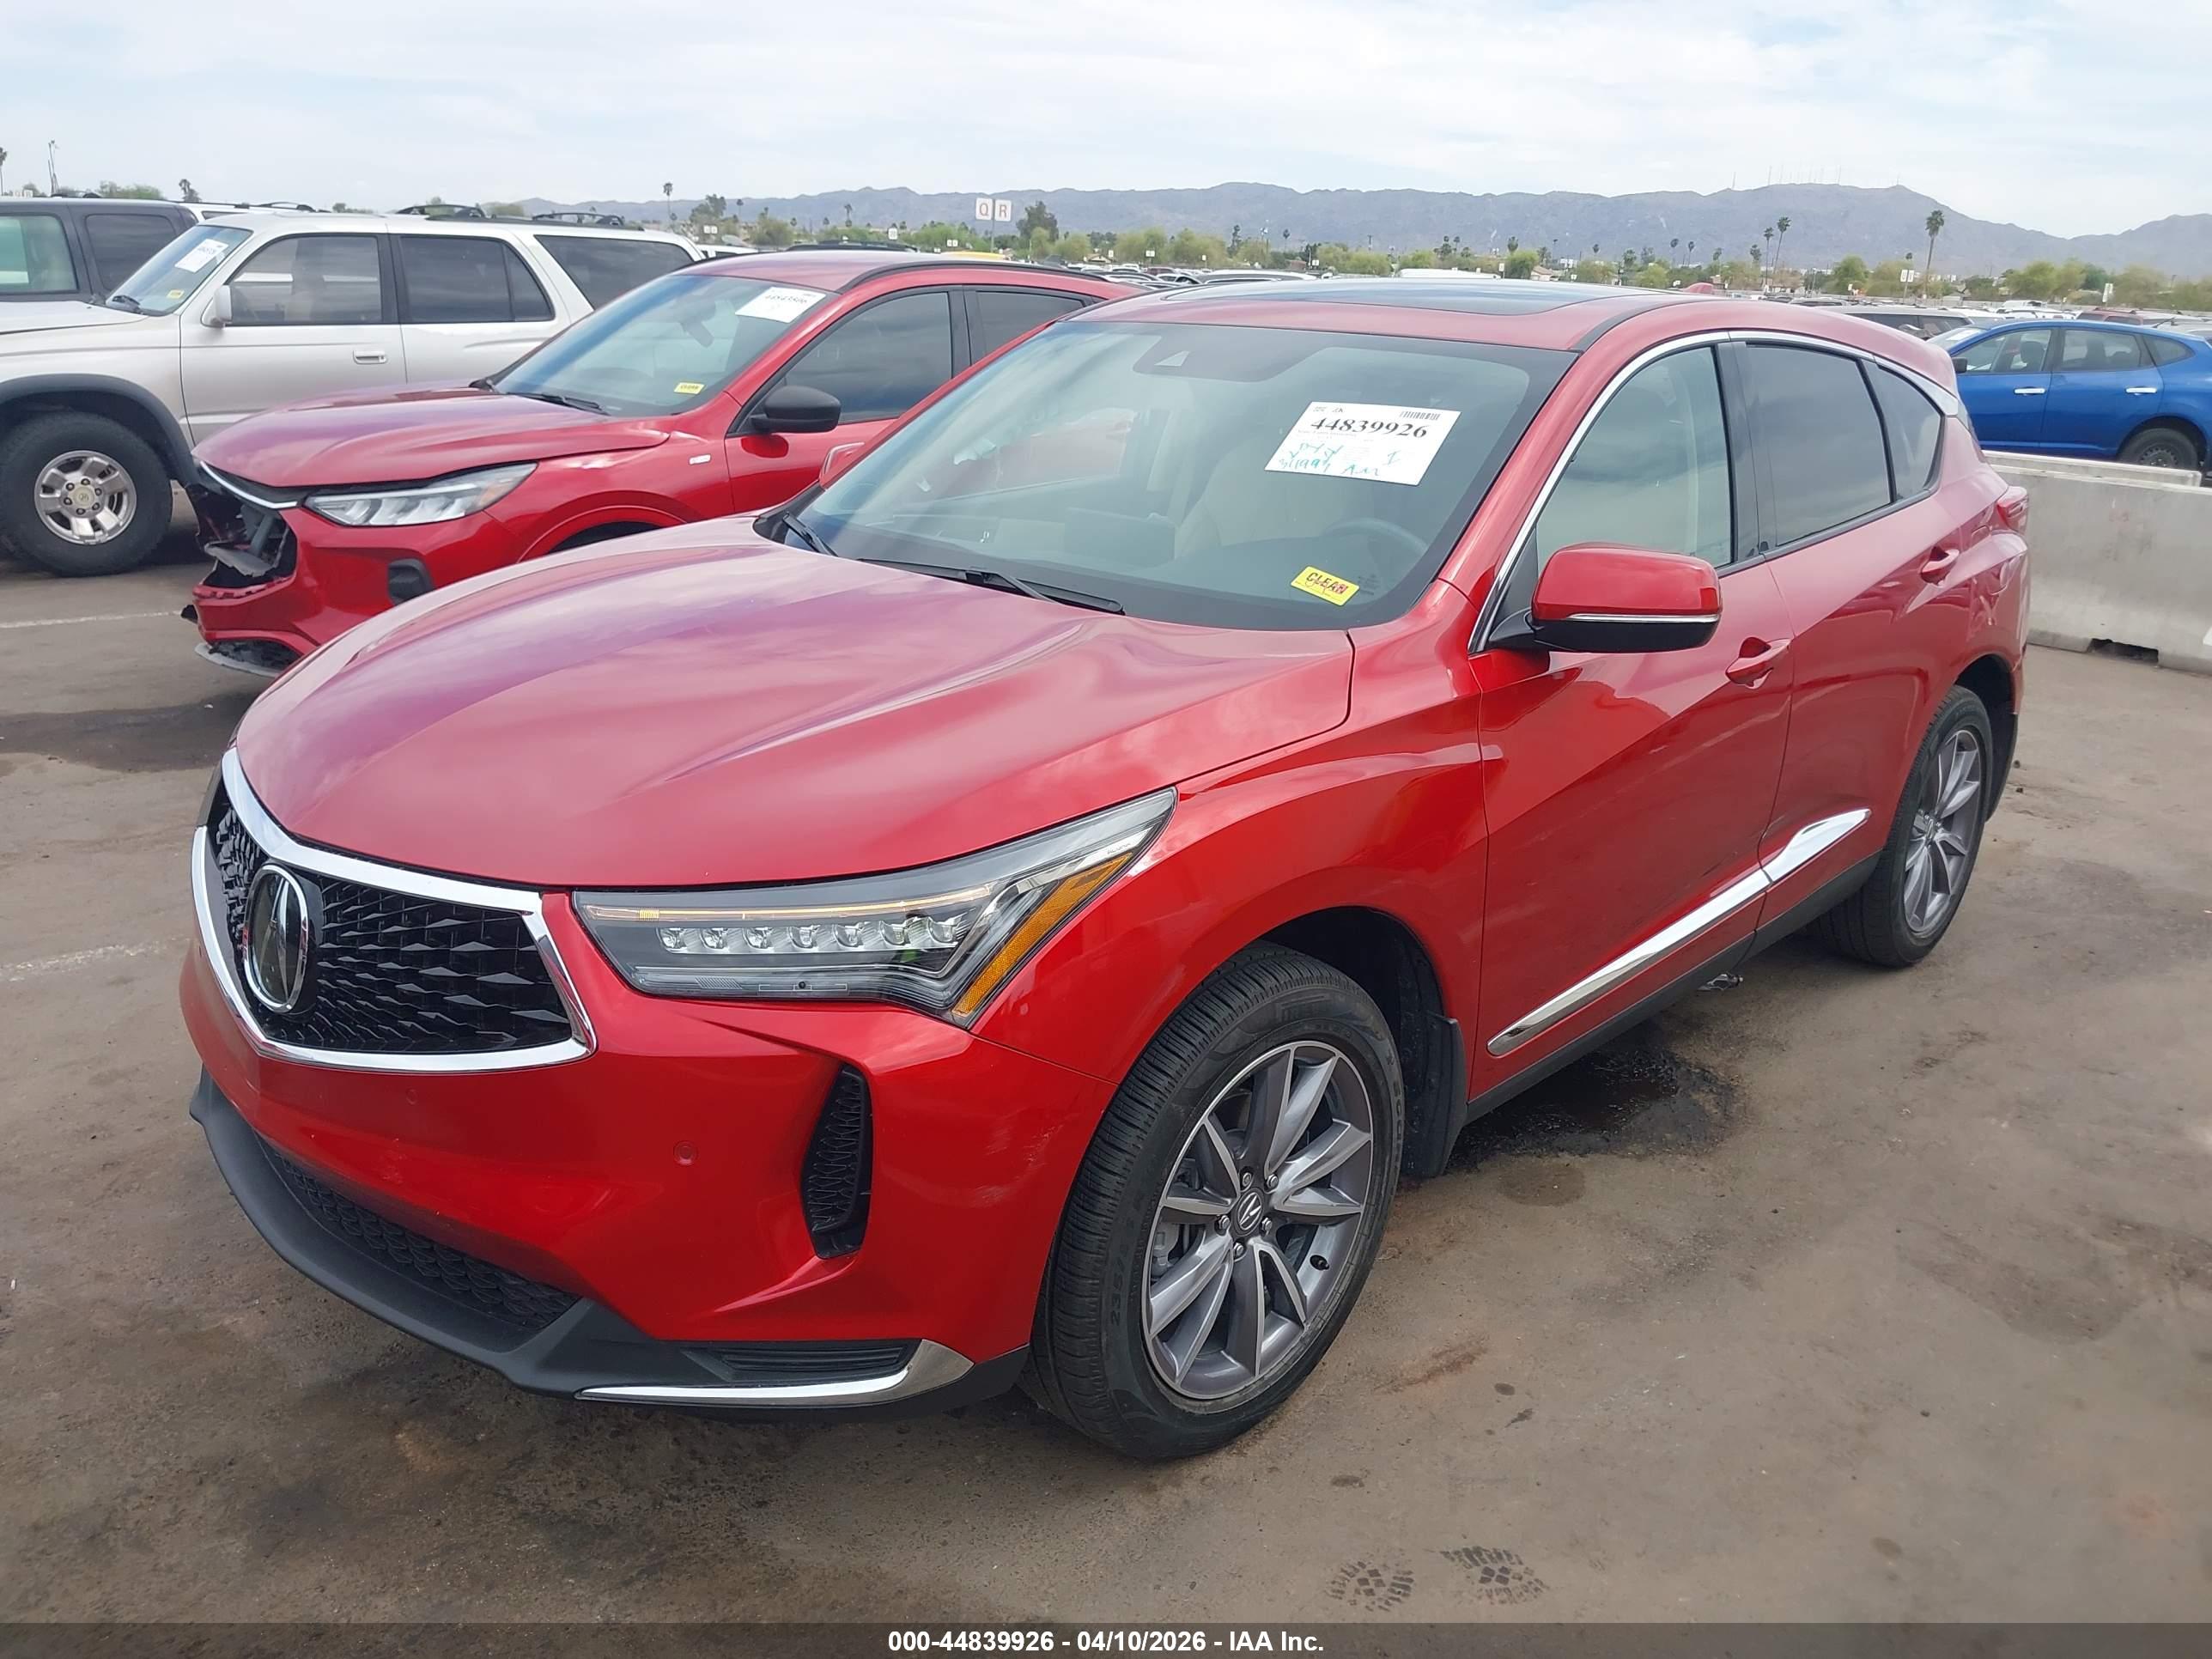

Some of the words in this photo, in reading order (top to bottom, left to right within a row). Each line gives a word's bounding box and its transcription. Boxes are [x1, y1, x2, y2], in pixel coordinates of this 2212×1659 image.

[979, 203, 989, 216] Q
[999, 204, 1007, 218] R
[1310, 417, 1431, 439] 44839926
[1305, 572, 1349, 594] CLEAN
